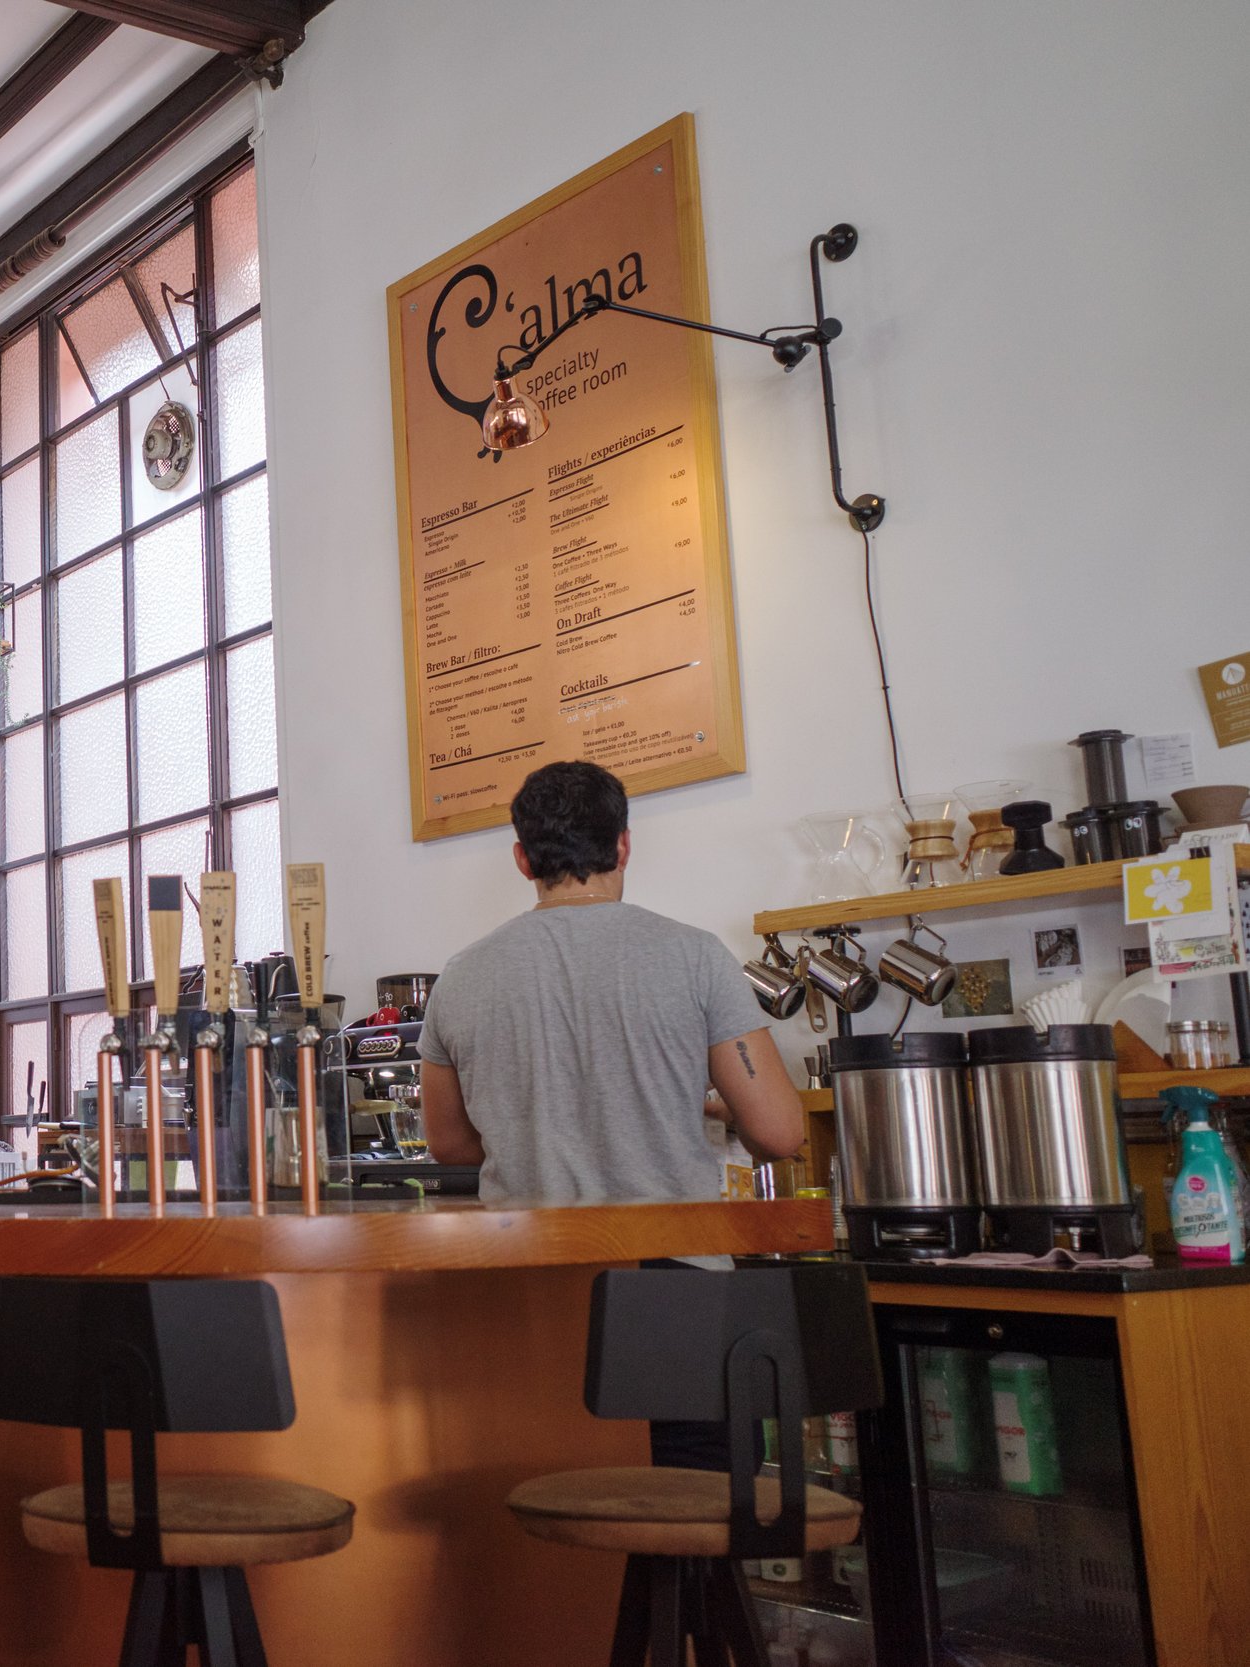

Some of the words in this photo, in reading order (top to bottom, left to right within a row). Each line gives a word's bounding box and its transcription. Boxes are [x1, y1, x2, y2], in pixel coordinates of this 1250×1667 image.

[526, 348, 600, 396] specialty
[538, 383, 578, 411] offee
[583, 361, 628, 394] room
[547, 458, 582, 479] Flights
[590, 426, 656, 461] experiências
[549, 483, 575, 497] Espresso
[575, 474, 594, 487] Flight
[421, 506, 459, 528] Espresso
[462, 500, 478, 513] Bar
[550, 513, 561, 523] The
[562, 503, 588, 517] Ultimate
[590, 494, 609, 508] Flight
[424, 531, 444, 542] Espresso
[553, 543, 568, 554] Brew
[570, 536, 587, 548] Flight
[424, 544, 450, 556] Americano
[553, 561, 563, 569] One
[564, 554, 581, 566] Coffee
[586, 548, 602, 559] Three
[603, 542, 618, 551] Ways
[554, 597, 570, 607] Three
[570, 590, 591, 602] Coffees
[593, 586, 604, 594] One
[605, 581, 617, 591] Way
[555, 581, 573, 592] Coffee
[574, 573, 592, 585] Flight
[556, 617, 571, 630] On
[574, 606, 602, 625] Draft
[426, 631, 442, 639] Mocha
[556, 640, 568, 648] Cold
[569, 635, 583, 645] Brew
[556, 647, 571, 656] Nitro
[571, 643, 584, 652] Cold
[584, 639, 599, 648] Brew
[599, 632, 618, 643] Coffee
[426, 660, 448, 673] Brew
[450, 655, 466, 667] Bar
[474, 645, 501, 660] filtro:
[435, 682, 452, 692] Choose
[452, 679, 463, 688] your
[464, 674, 479, 683] coffee
[483, 668, 502, 678] escolhe
[435, 697, 453, 707] Choose
[453, 694, 464, 703] your
[465, 689, 484, 698] method
[488, 682, 507, 692] escolhe
[512, 675, 533, 686] método
[561, 674, 608, 696] Cocktails
[1216, 683, 1250, 701] MANHATT
[446, 712, 466, 722] Chemex
[502, 696, 528, 708] Aeropress
[455, 730, 470, 738] doses
[429, 752, 446, 764] Tea
[454, 744, 472, 758] Chá
[212, 918, 223, 995] WATER
[304, 945, 312, 972] BREW
